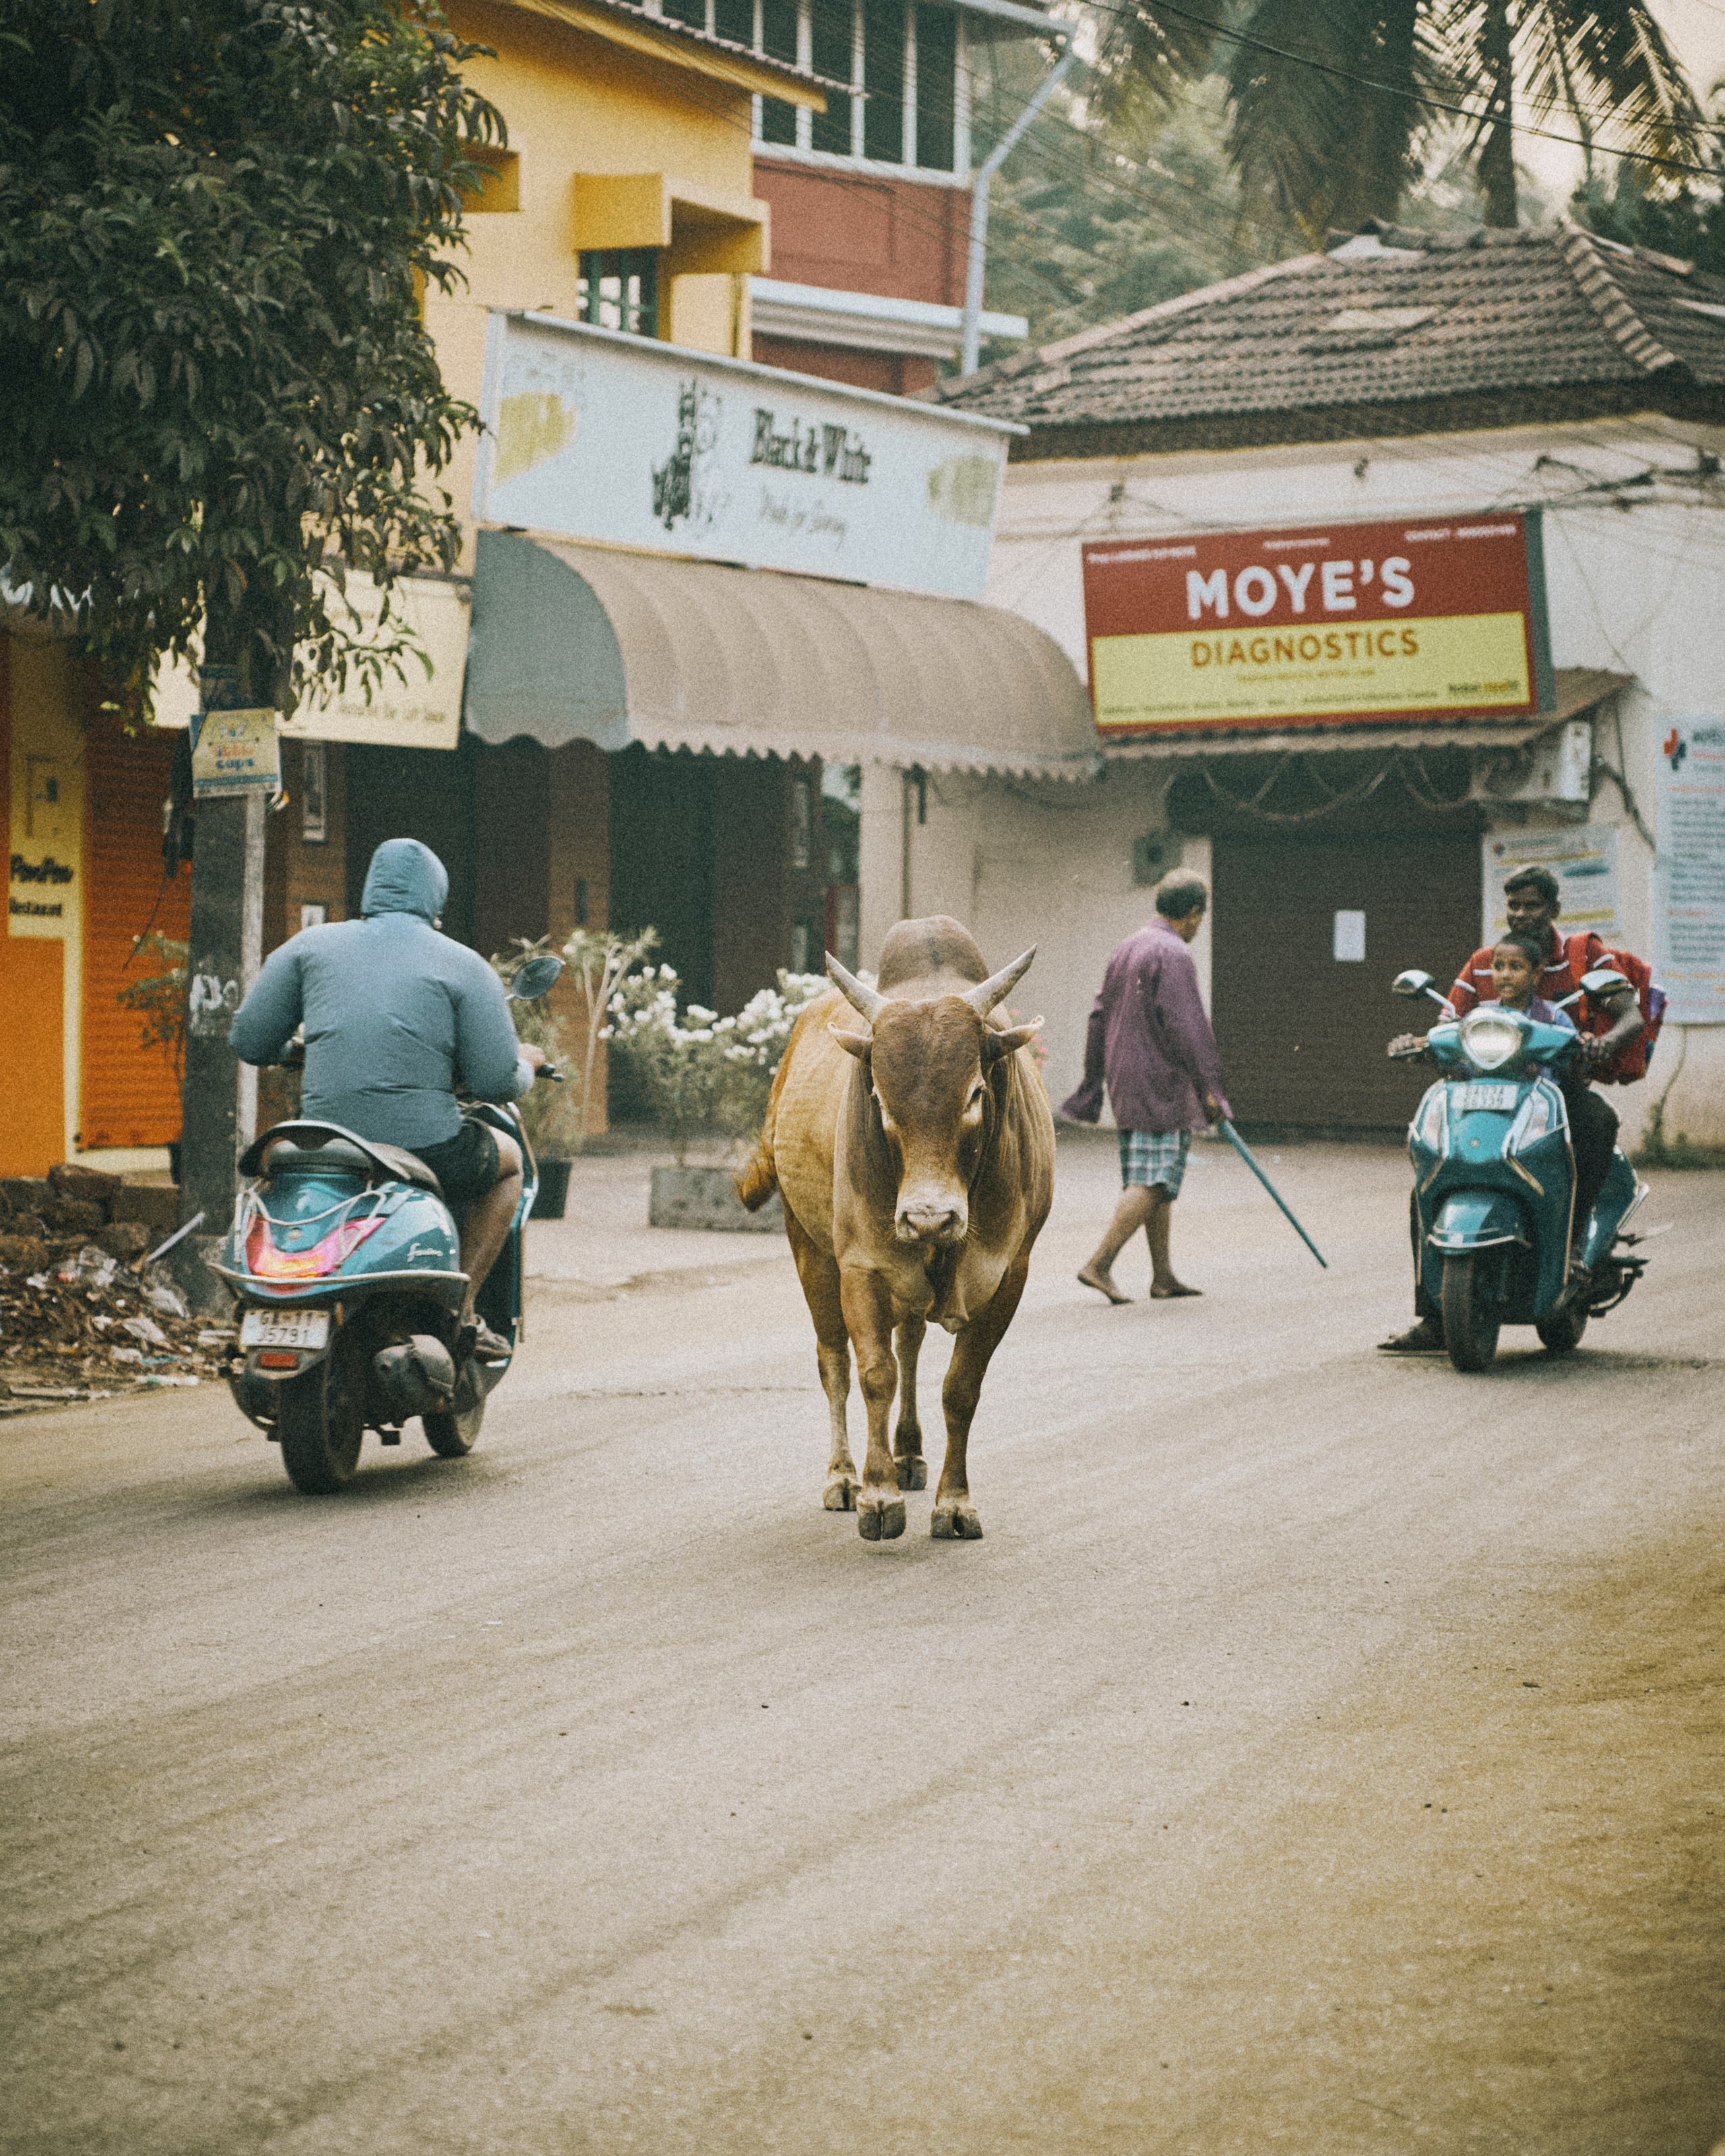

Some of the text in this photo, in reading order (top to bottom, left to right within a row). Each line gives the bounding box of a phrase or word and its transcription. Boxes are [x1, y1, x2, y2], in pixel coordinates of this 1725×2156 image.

[749, 408, 802, 470] Black
[822, 422, 871, 484] White
[1186, 557, 1415, 619] MOYE'S
[1191, 627, 1420, 668] DIAGNOSTICS
